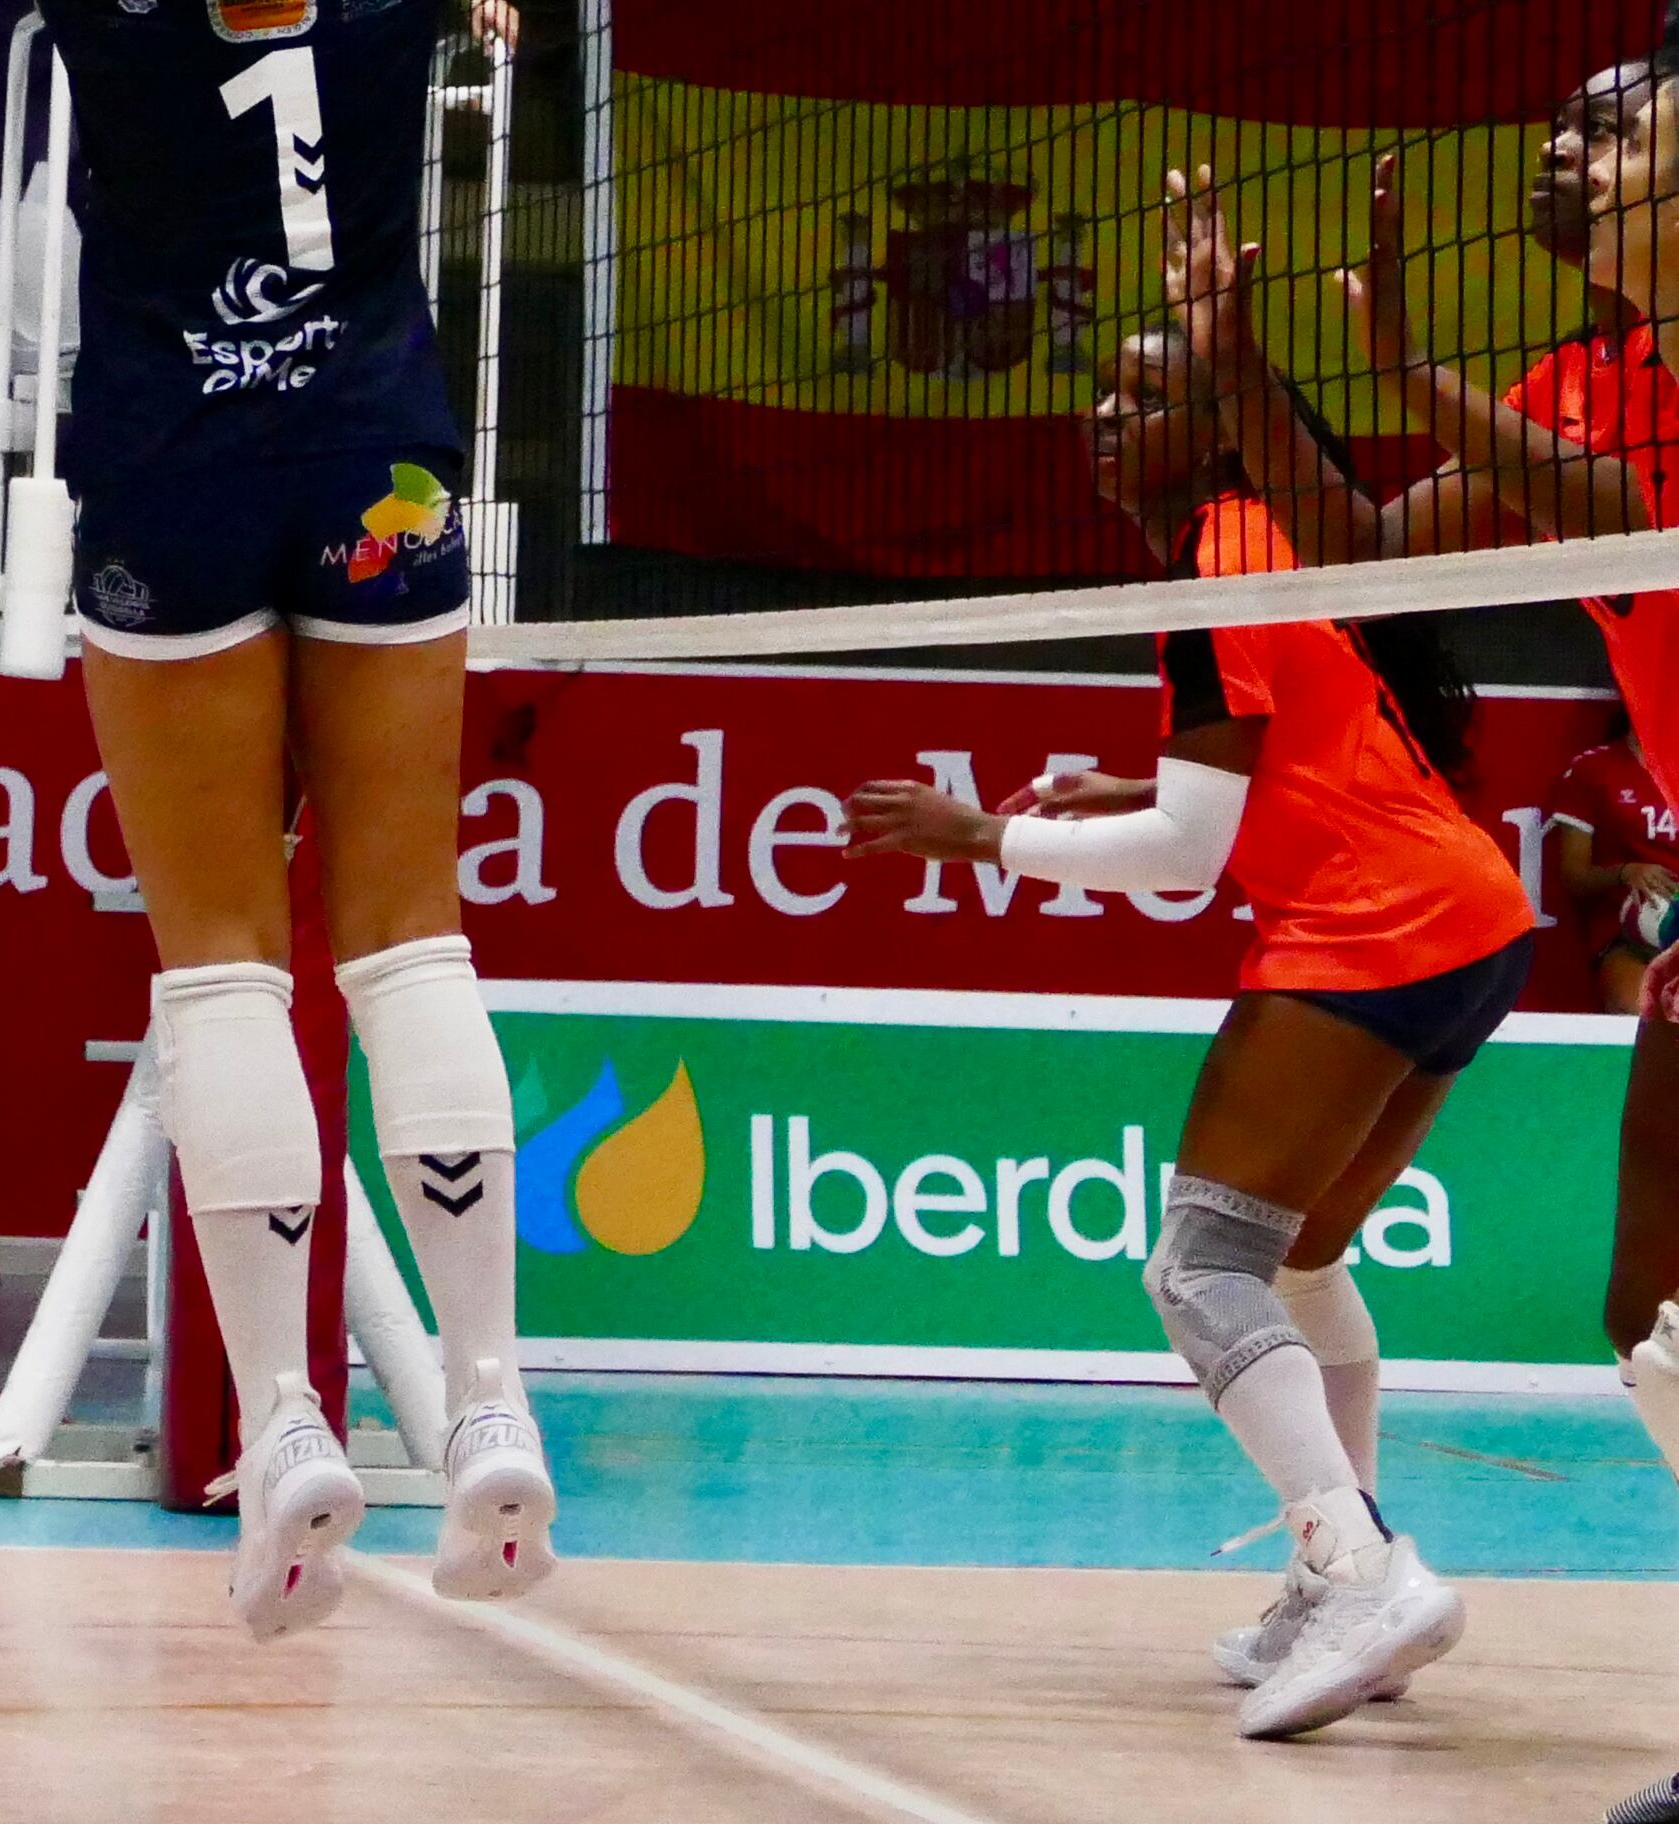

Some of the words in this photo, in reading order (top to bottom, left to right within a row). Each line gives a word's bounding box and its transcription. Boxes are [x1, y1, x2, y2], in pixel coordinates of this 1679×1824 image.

[218, 45, 335, 270] 1
[613, 728, 849, 916] de
[749, 1112, 1453, 1269] Iberda
